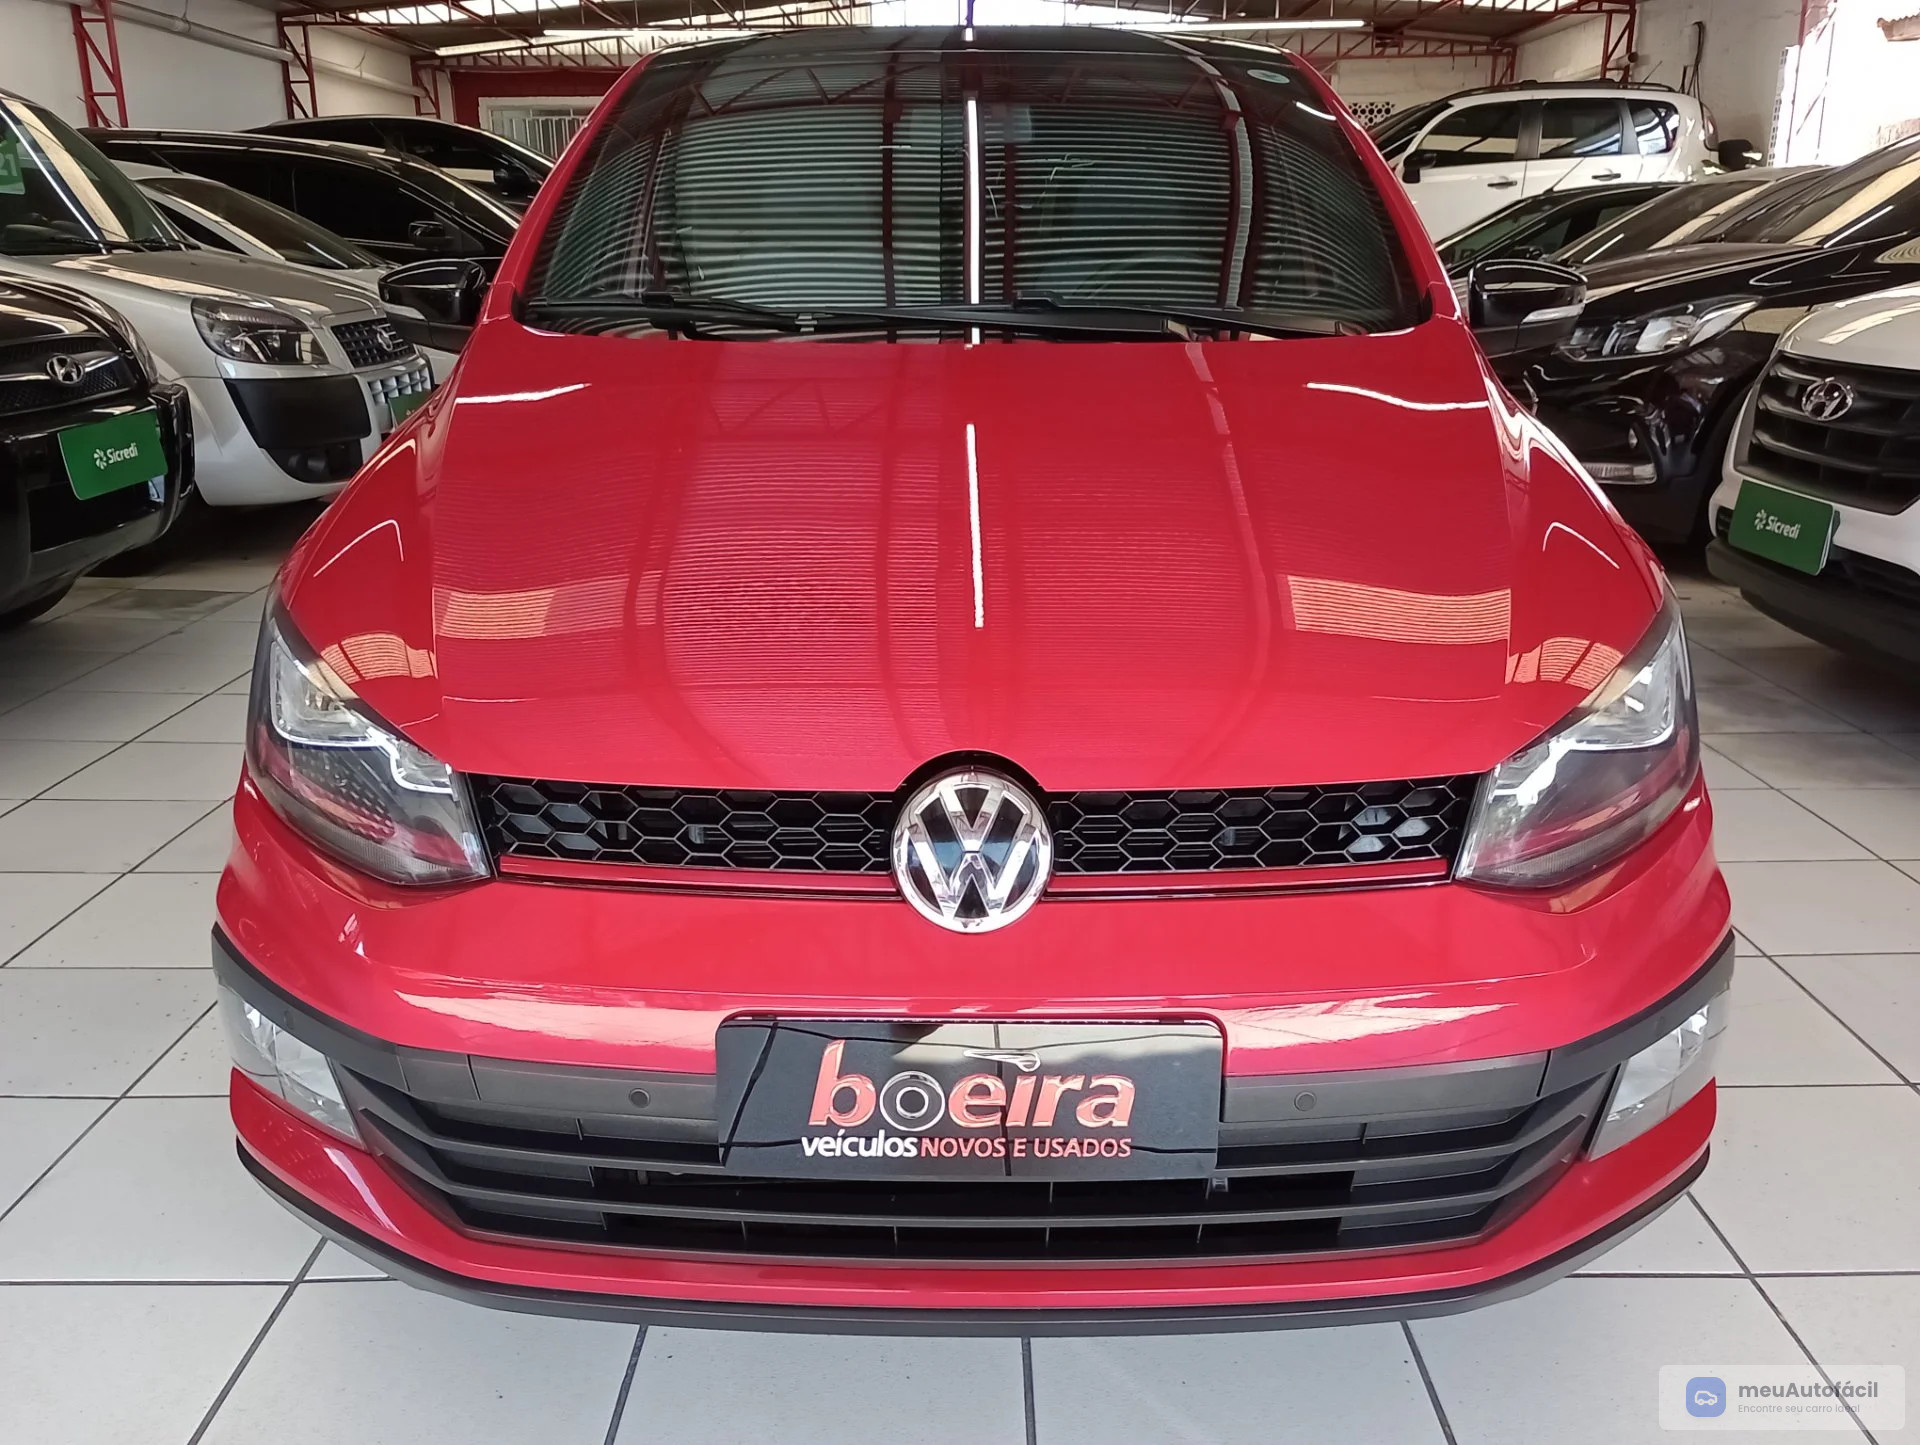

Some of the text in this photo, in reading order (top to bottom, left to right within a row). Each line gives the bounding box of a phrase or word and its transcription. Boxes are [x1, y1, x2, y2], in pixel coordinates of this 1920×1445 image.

[106, 442, 138, 464] Sicredi
[1765, 515, 1801, 540] Sicredi
[808, 1039, 1135, 1131] boeira
[801, 1129, 1132, 1158] veículos NOVOS E USADOS
